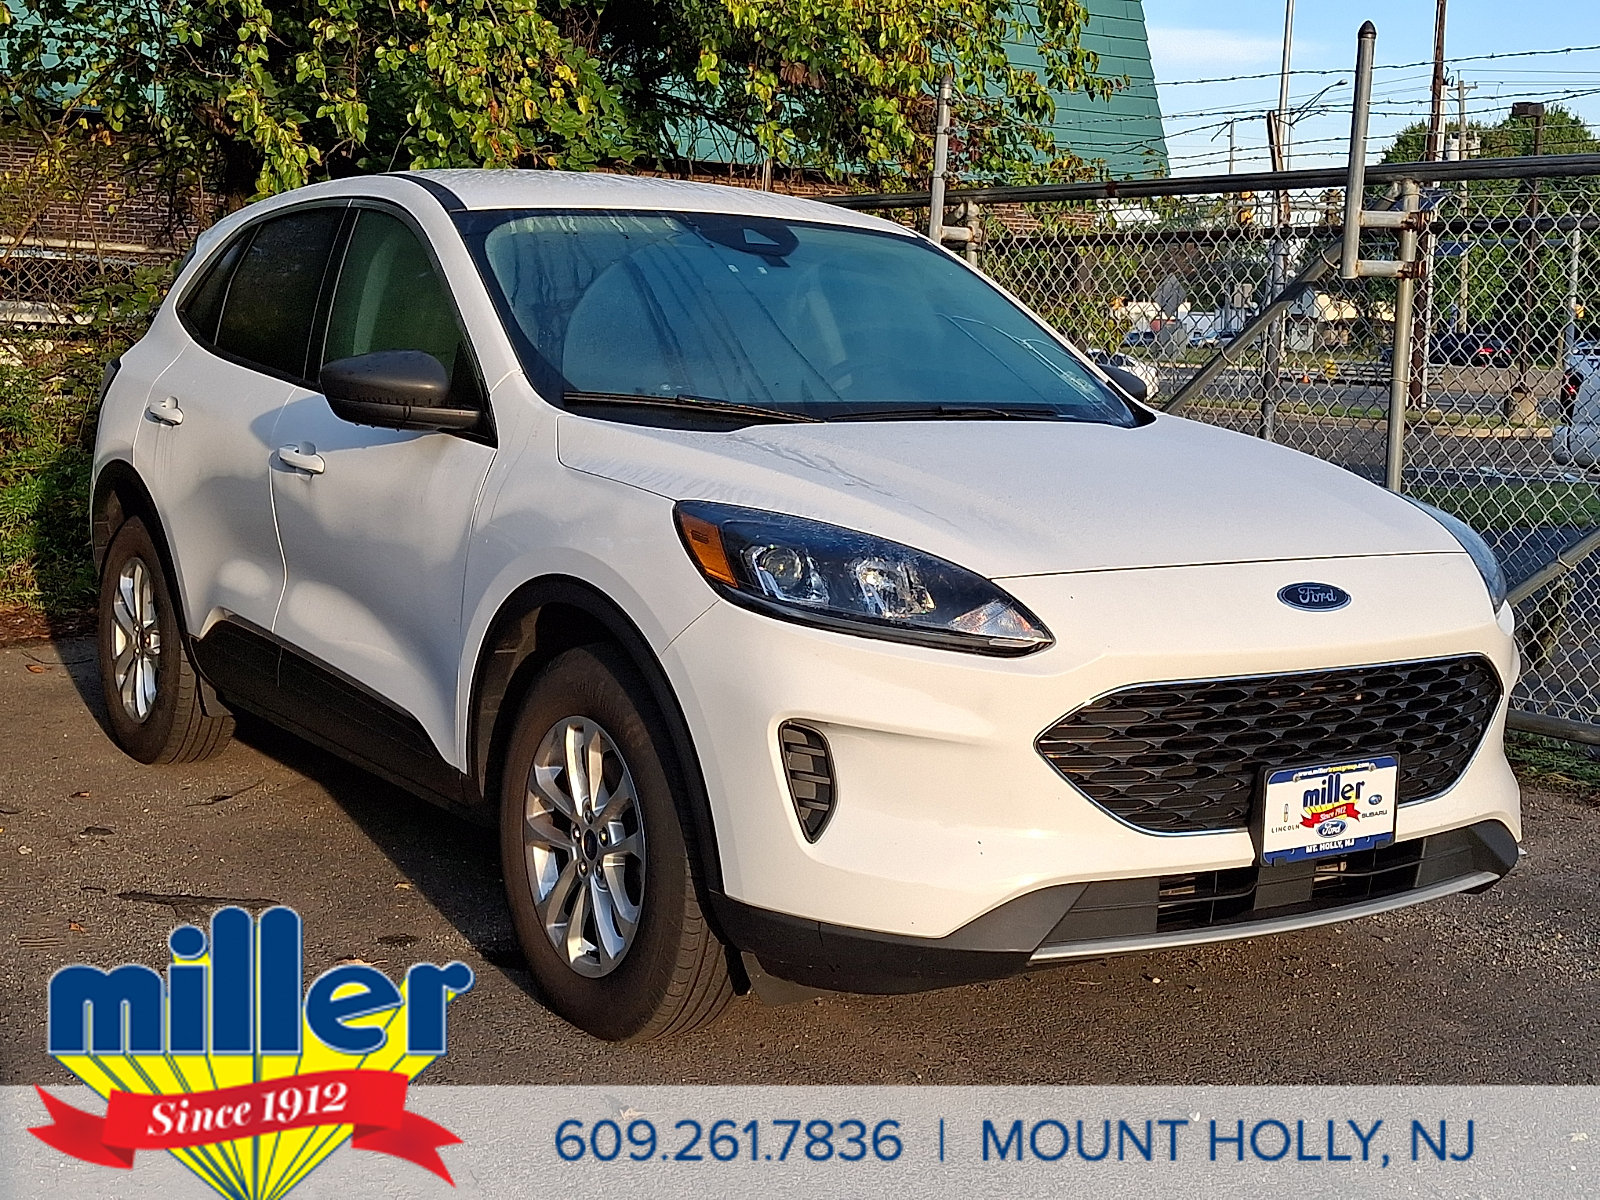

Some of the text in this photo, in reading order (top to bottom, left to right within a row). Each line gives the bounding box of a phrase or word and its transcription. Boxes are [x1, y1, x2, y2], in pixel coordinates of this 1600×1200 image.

[1298, 586, 1337, 604] Ford
[1303, 774, 1365, 807] miller
[1361, 810, 1388, 819] SUBARU
[1271, 824, 1300, 834] LINCOLN
[1306, 838, 1355, 854] MT. HOLLY, NJ
